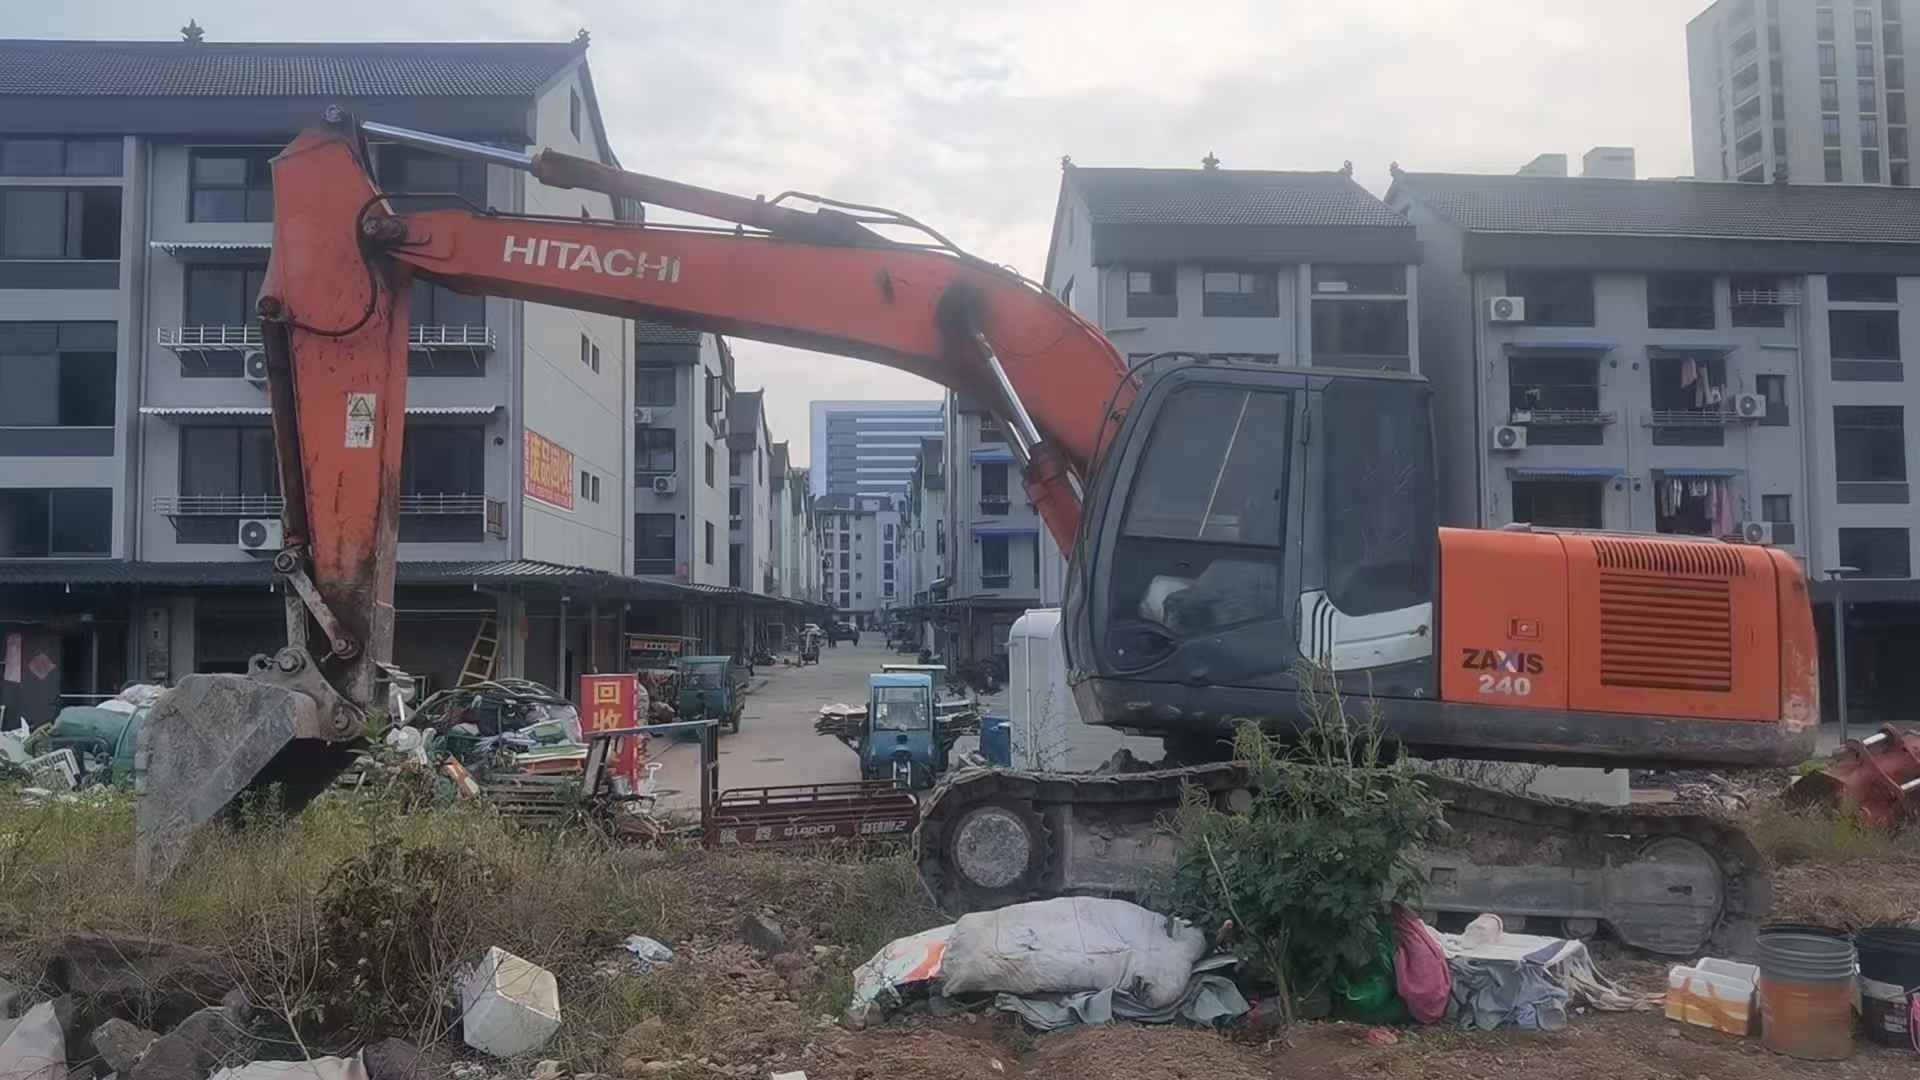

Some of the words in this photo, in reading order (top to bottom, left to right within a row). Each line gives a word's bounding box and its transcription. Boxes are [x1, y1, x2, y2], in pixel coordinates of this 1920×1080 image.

[503, 235, 681, 284] HITACHI
[1462, 648, 1543, 674] ZAXIS
[1479, 674, 1531, 696] 240
[593, 681, 623, 731] 回收
